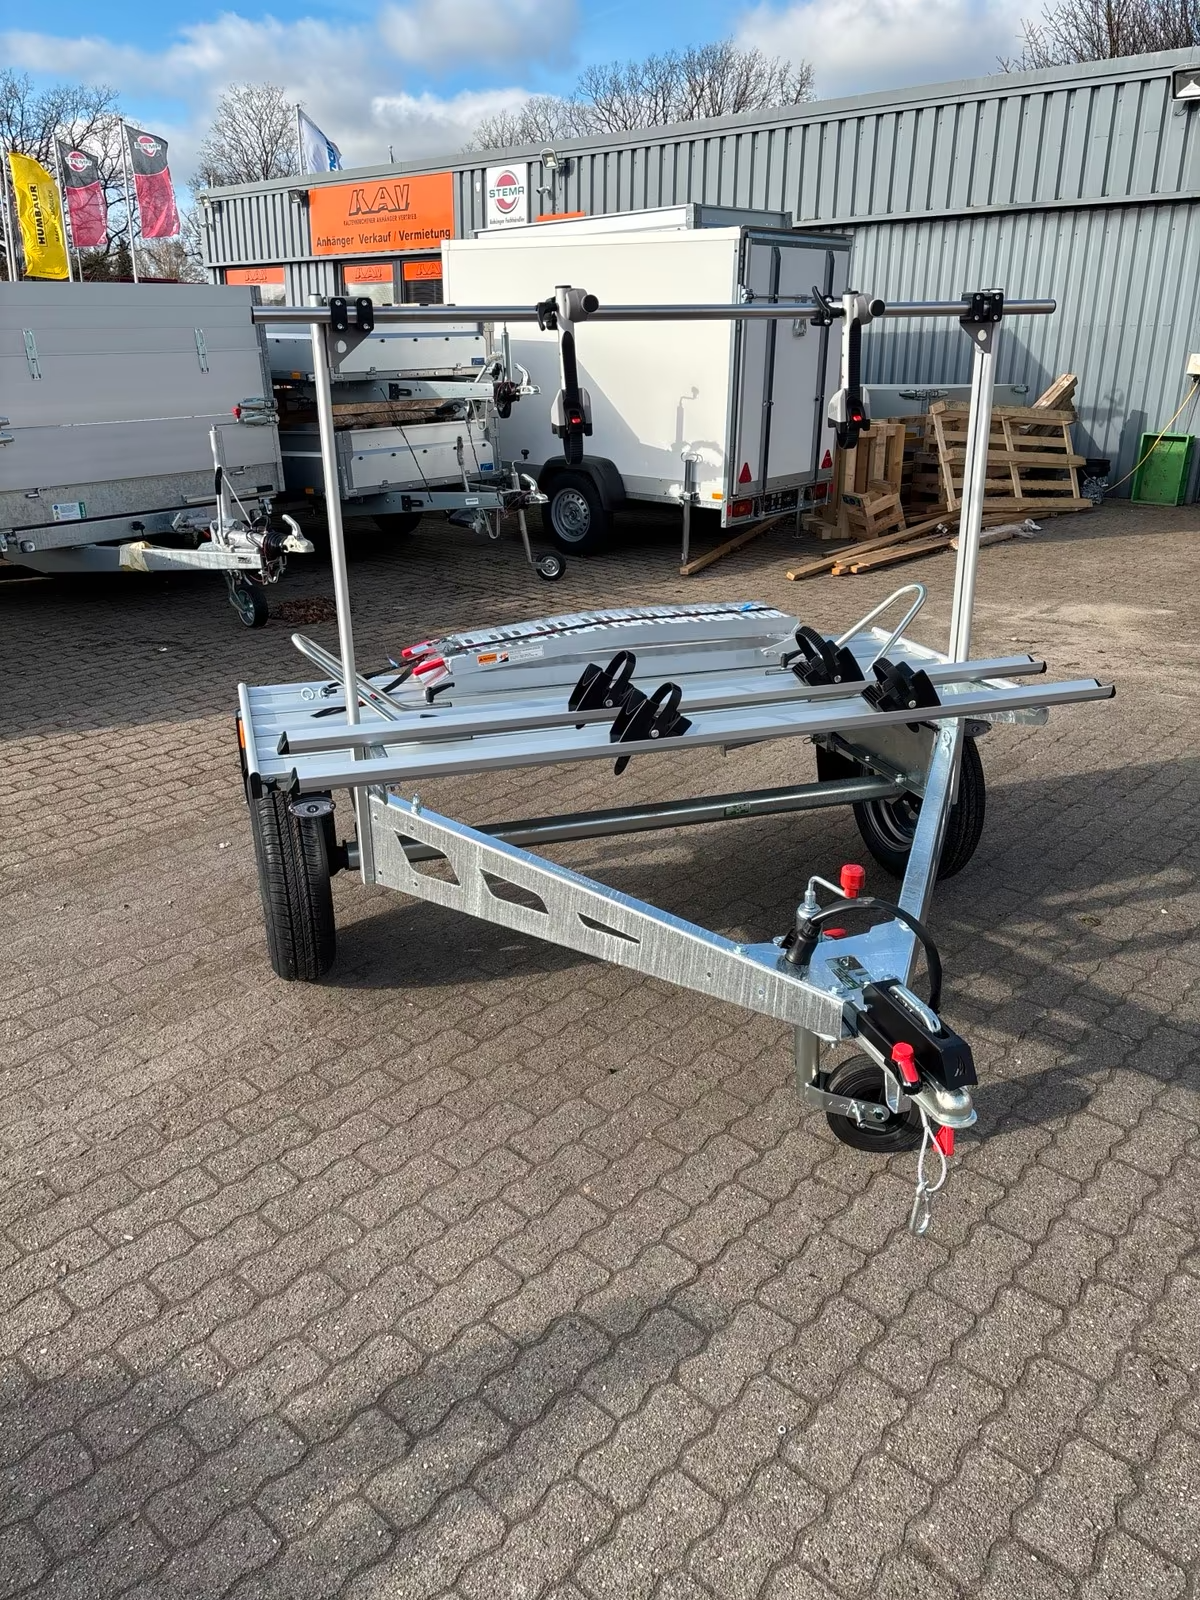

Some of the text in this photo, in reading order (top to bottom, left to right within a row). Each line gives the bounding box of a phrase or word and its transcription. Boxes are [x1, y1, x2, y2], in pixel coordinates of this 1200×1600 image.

[348, 184, 410, 216] KAV
[489, 186, 525, 198] STEMA
[30, 185, 46, 245] HUMBAUR
[316, 235, 354, 248] Anhänger
[358, 231, 391, 244] Verkauf
[398, 228, 451, 240] Vermietung
[416, 263, 442, 276] KA
